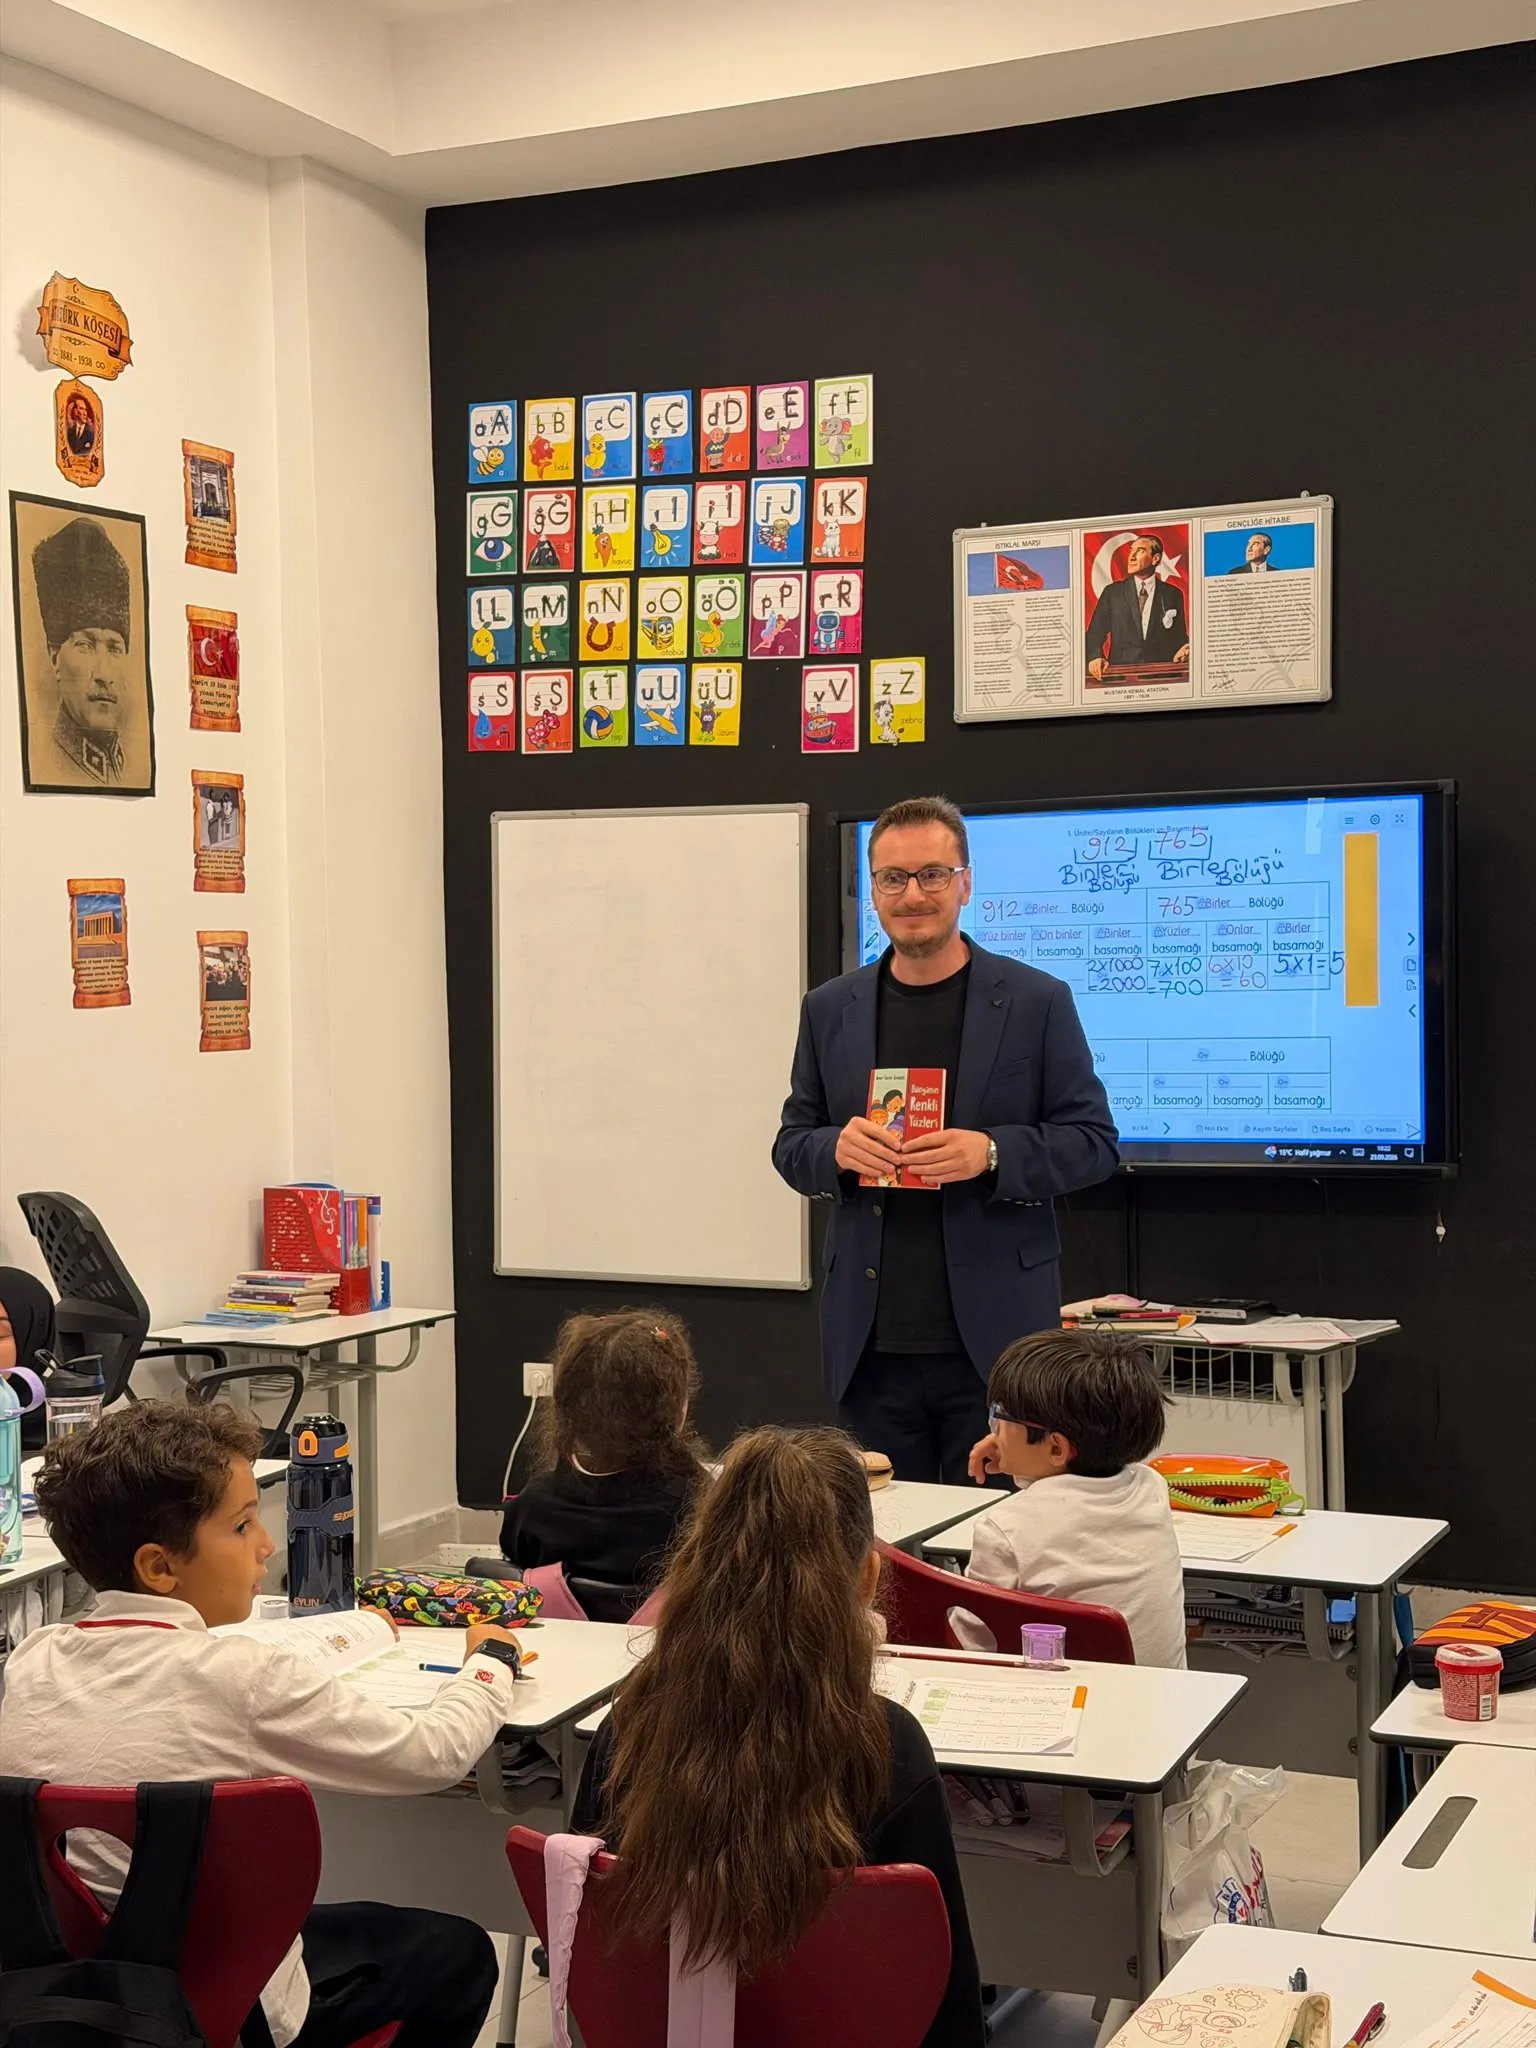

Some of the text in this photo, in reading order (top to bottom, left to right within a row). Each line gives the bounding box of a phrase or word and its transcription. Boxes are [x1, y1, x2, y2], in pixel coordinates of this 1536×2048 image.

[84, 315, 119, 344] KÖŞESİ
[60, 350, 73, 362] 1881
[78, 355, 93, 367] 1938
[1226, 516, 1292, 528] GENÇLİĞE HİTABE
[1082, 836, 1135, 860] 912
[1032, 902, 1104, 916] Binler Bölüğü
[1157, 896, 1198, 918] 765
[1205, 896, 1284, 910] Birler Bölüğü
[982, 900, 1022, 923] 912
[1104, 927, 1131, 938] Binler
[1162, 926, 1191, 937] Yüzler
[1226, 924, 1254, 936] Onlar
[1285, 922, 1311, 934] Birler
[1036, 946, 1084, 958] basamağı
[1094, 944, 1142, 956] basamağı
[1152, 943, 1202, 956] basamağı
[1212, 941, 1262, 954] basamağı
[1272, 940, 1324, 952] basamağı
[1250, 1050, 1285, 1064] Bölüğü
[910, 1096, 938, 1112] Renkli
[1153, 1094, 1203, 1108] basamağı
[1213, 1094, 1264, 1108] basamağı
[1274, 1094, 1326, 1108] basamağı
[909, 1114, 938, 1128] Yüzleri
